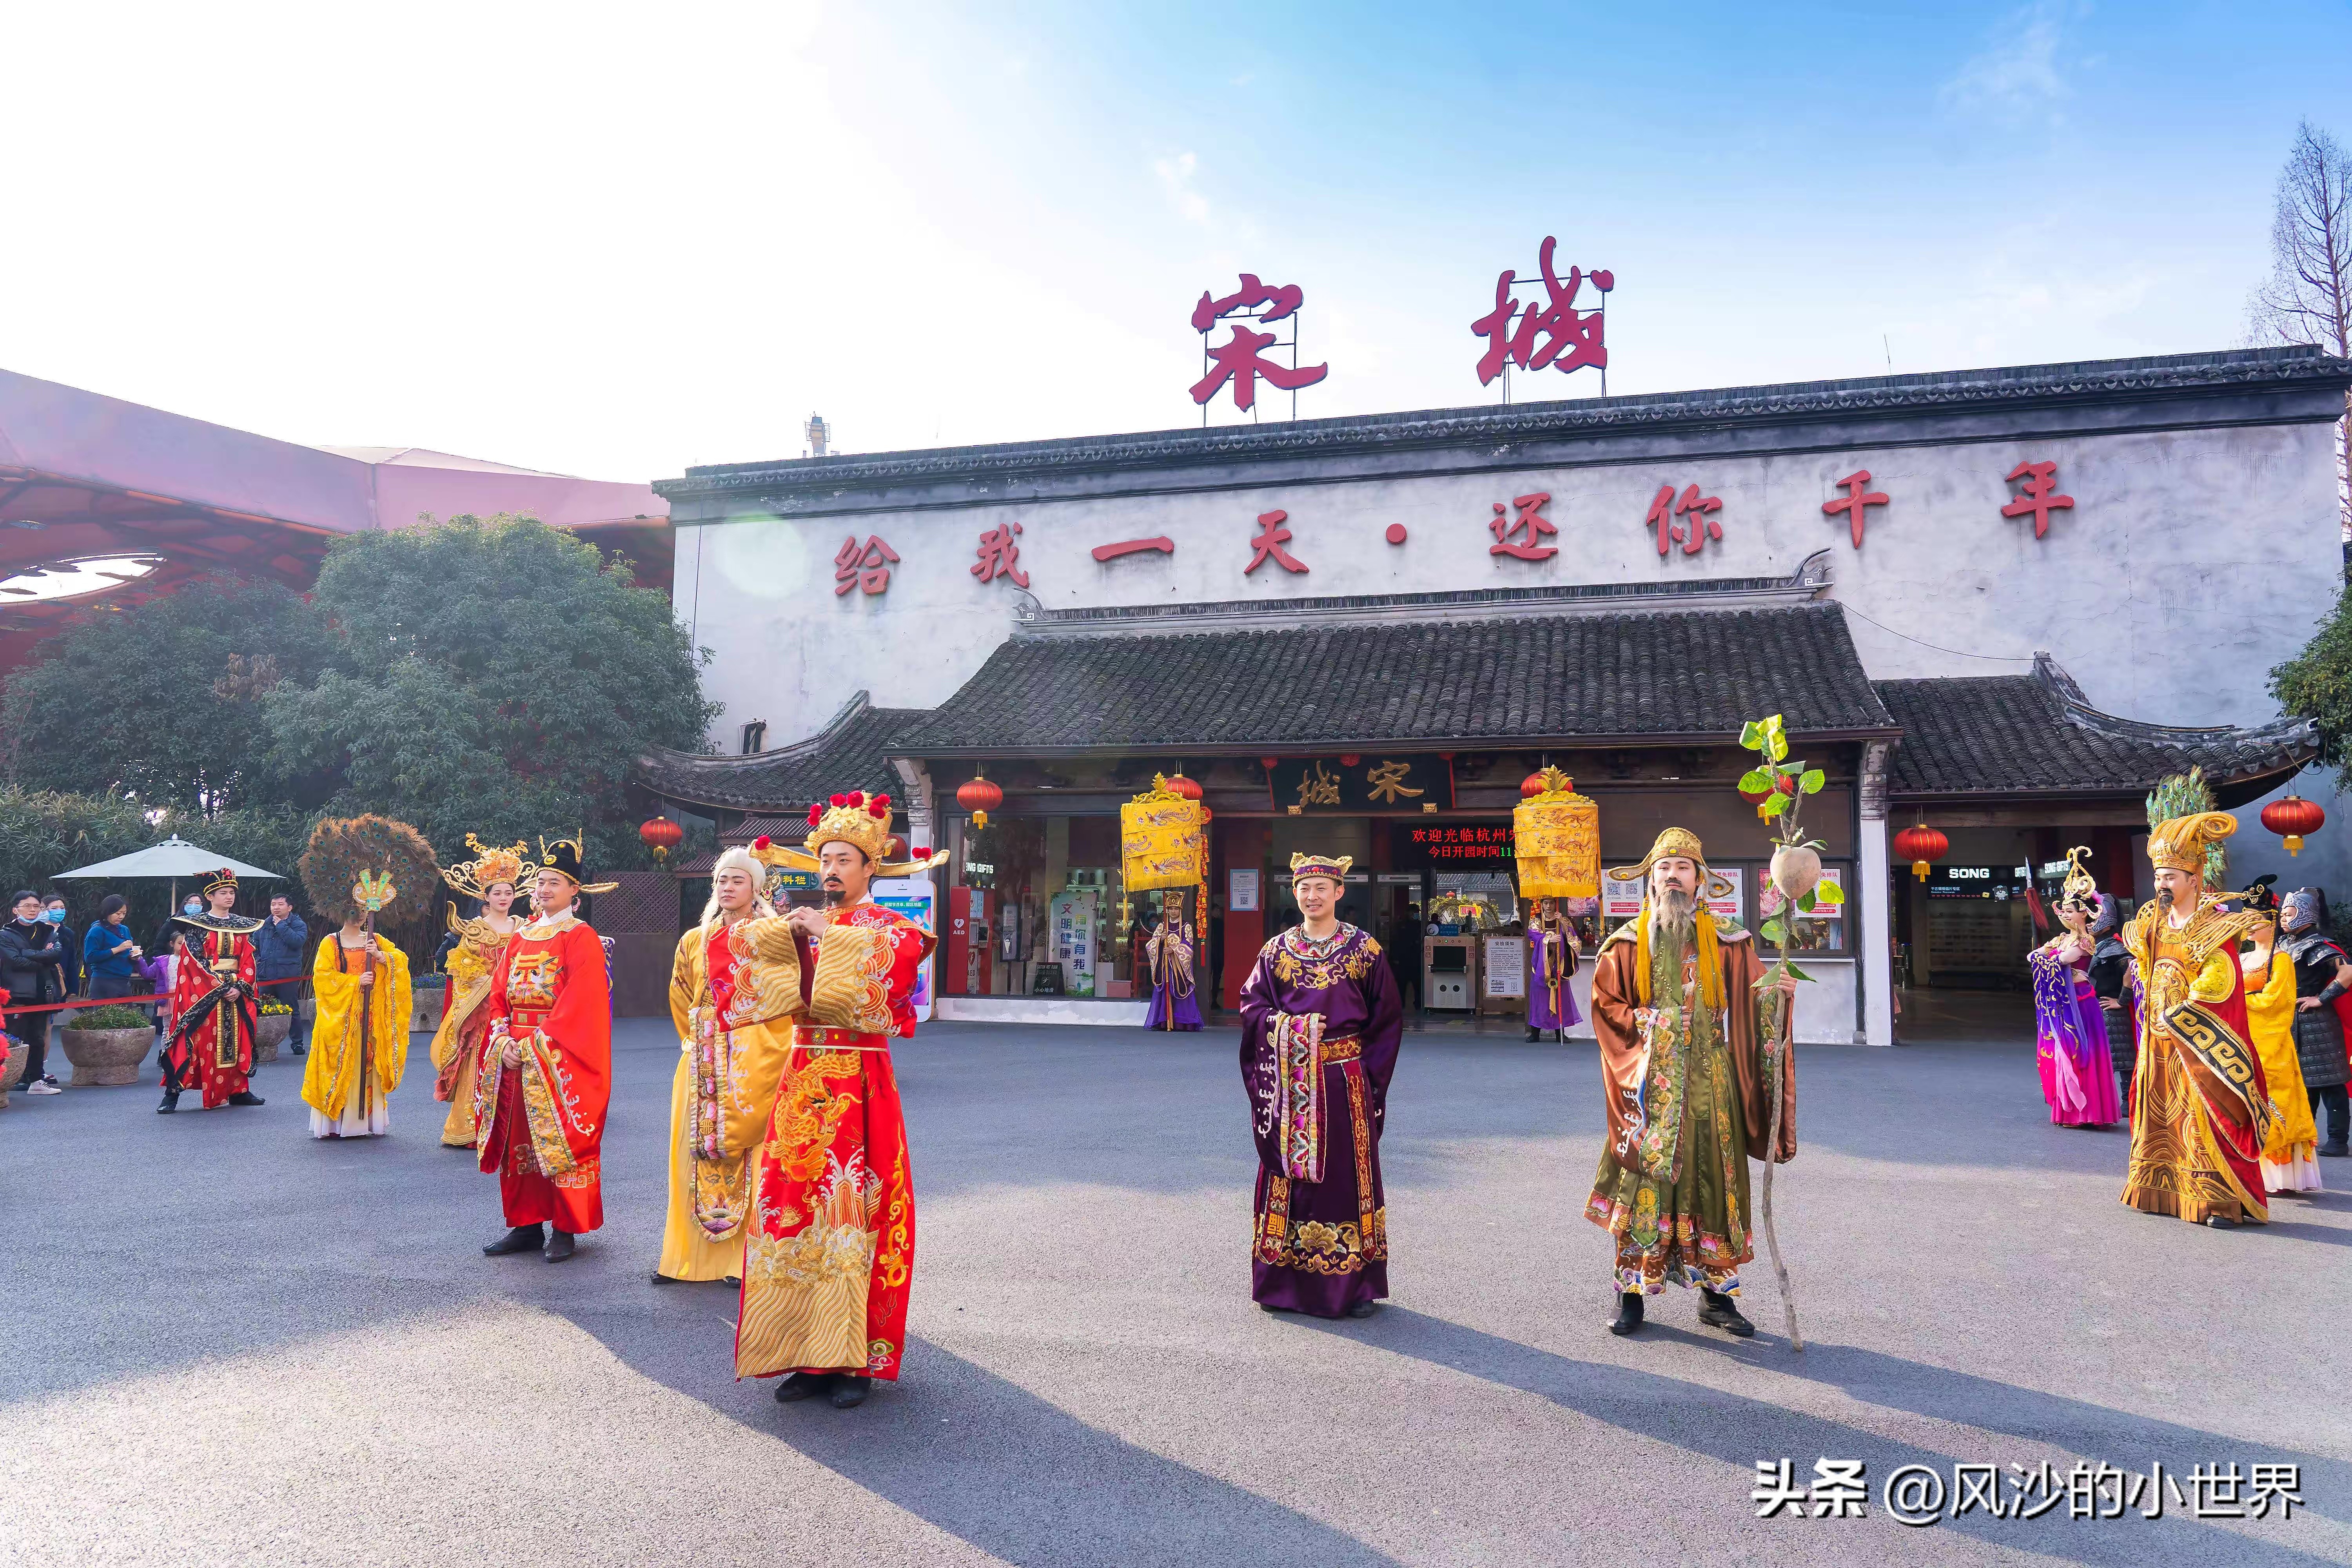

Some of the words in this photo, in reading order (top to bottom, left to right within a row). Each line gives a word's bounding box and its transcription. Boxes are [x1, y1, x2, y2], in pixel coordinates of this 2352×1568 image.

[1189, 236, 1614, 412] 宋城
[977, 864, 993, 874] GIFTS
[1949, 868, 1989, 878] SONG
[1060, 904, 1073, 959] 文明健康
[1073, 914, 1087, 970] 有你有我
